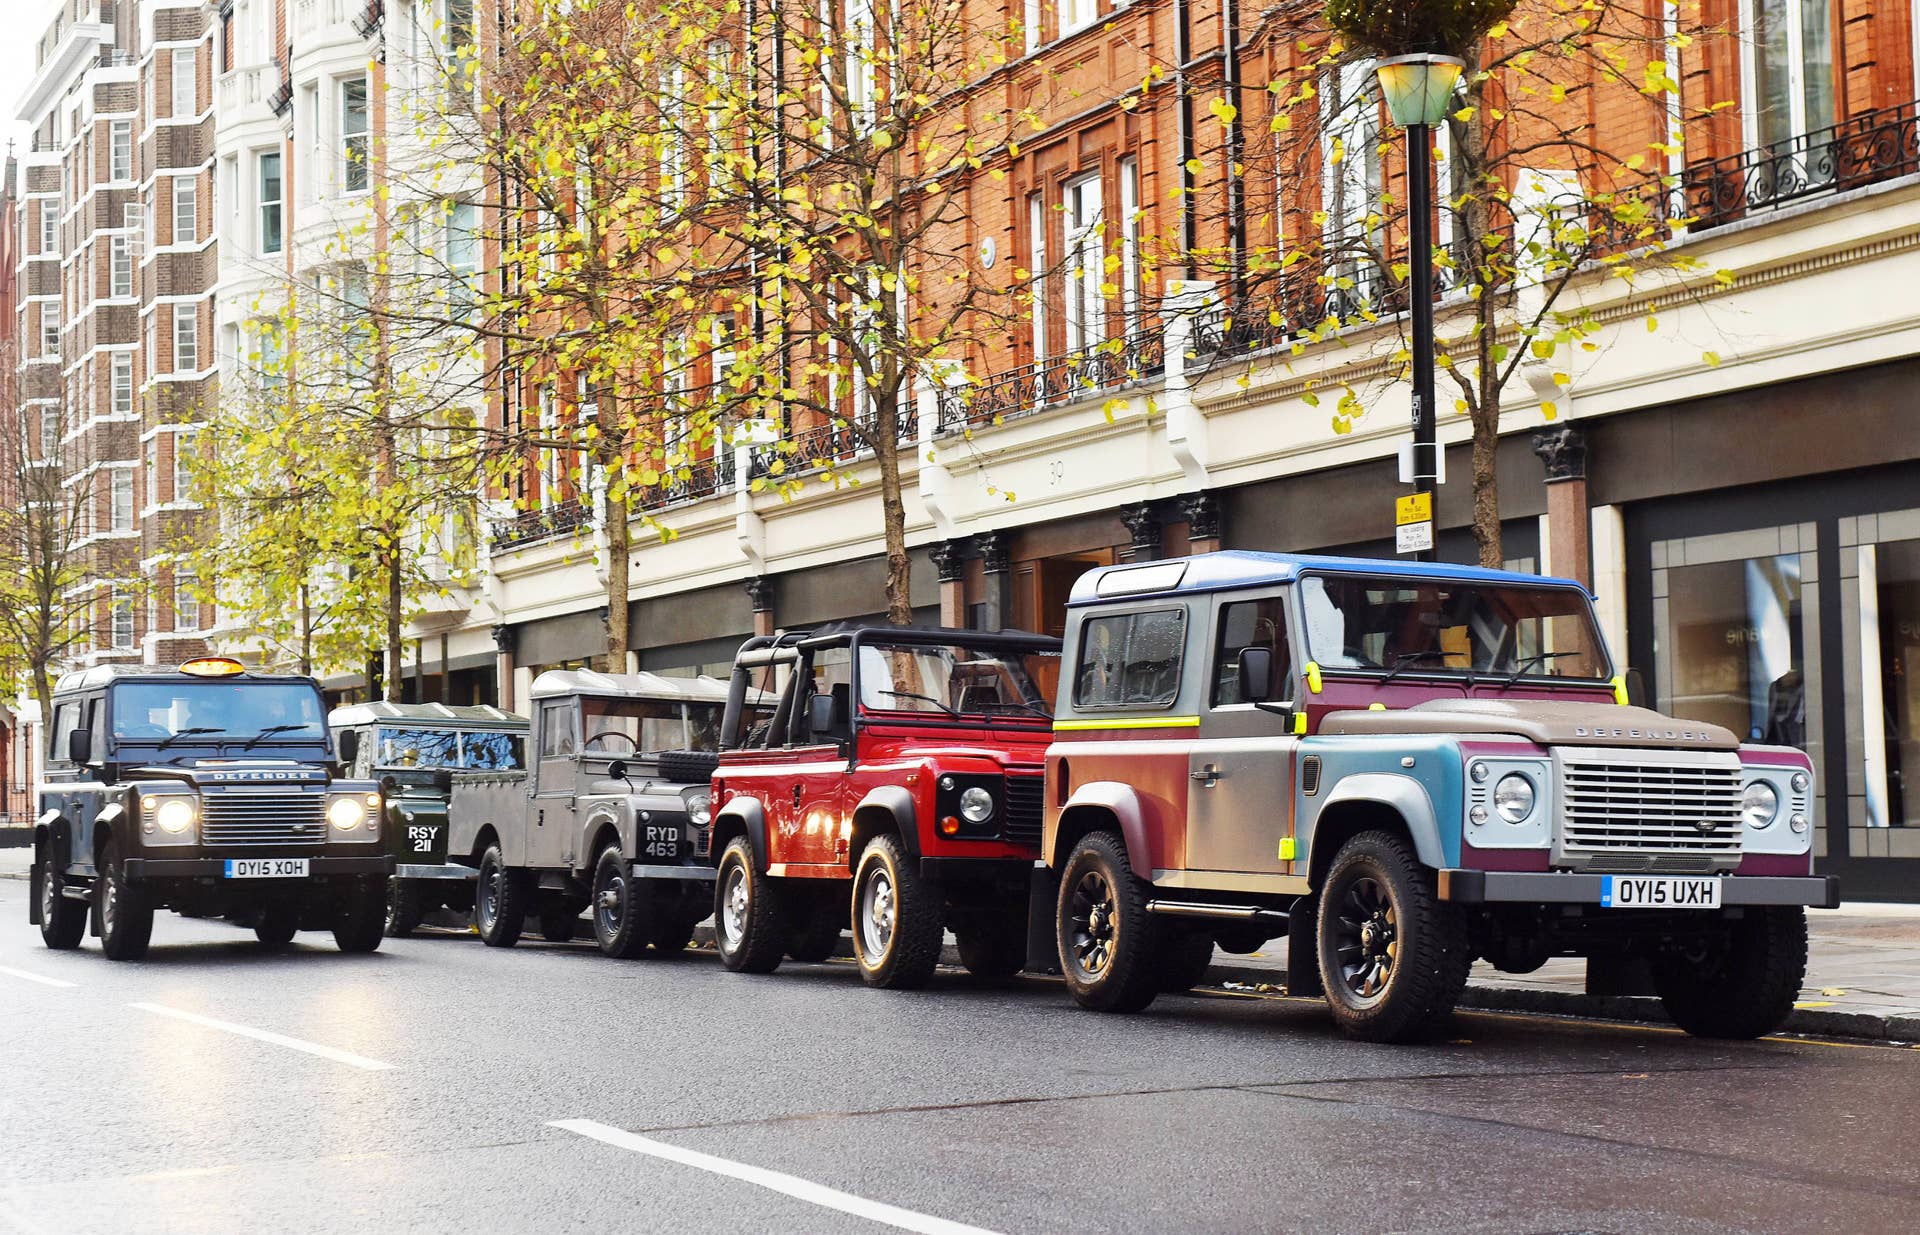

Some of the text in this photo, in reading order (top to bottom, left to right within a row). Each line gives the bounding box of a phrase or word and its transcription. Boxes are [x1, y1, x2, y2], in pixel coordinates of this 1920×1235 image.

[1574, 727, 1712, 742] DEFENDER
[213, 772, 311, 780] DEFENDER
[408, 826, 439, 839] RSY
[646, 826, 678, 842] RYD
[413, 839, 432, 852] 211
[645, 841, 677, 857] 463
[238, 861, 303, 876] OY15 XOH
[1620, 880, 1713, 904] OY15 UXH
